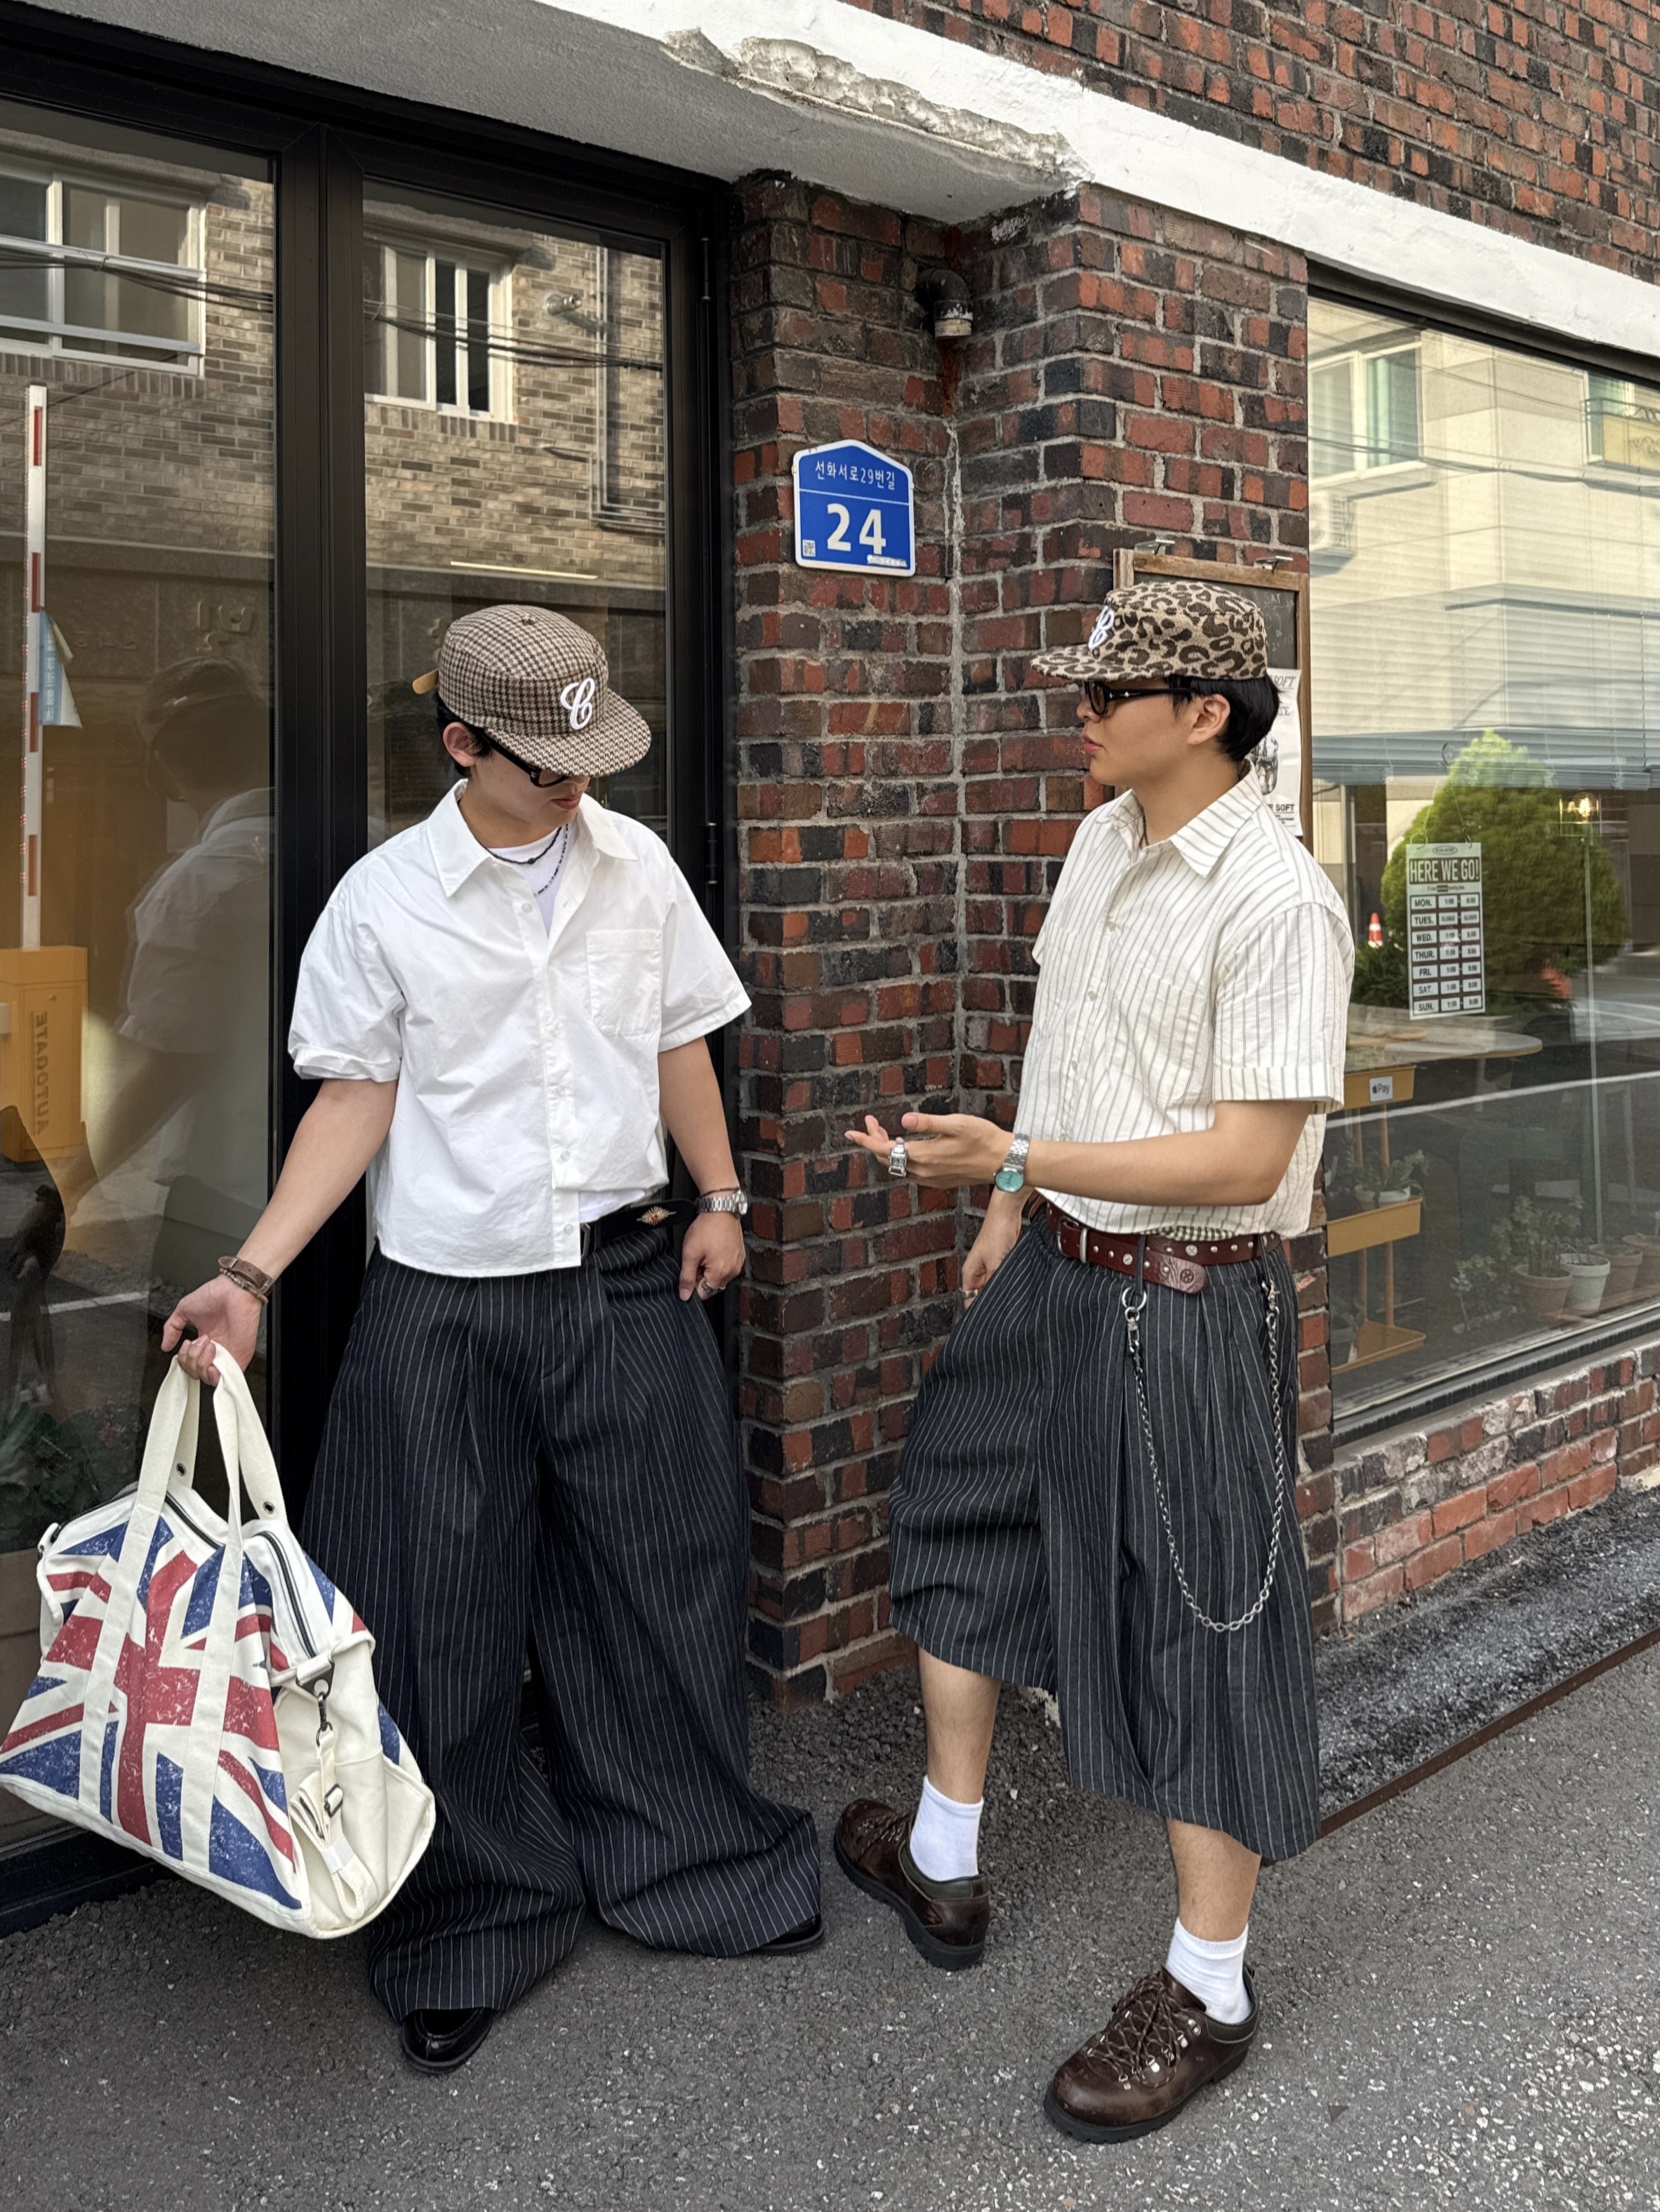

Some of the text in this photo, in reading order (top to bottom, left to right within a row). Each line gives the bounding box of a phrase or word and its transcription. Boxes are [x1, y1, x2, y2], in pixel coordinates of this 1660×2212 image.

[815, 461, 895, 491] 선화서로29번길
[827, 503, 887, 555] 24
[1410, 859, 1479, 882] HERE WE GO!
[1414, 916, 1433, 925] TUES.
[1416, 934, 1433, 942] WED.
[1415, 951, 1435, 959] THUR.
[1419, 986, 1433, 994] SAT.
[1419, 1002, 1434, 1011] SUN.
[1378, 1083, 1390, 1094] Pay
